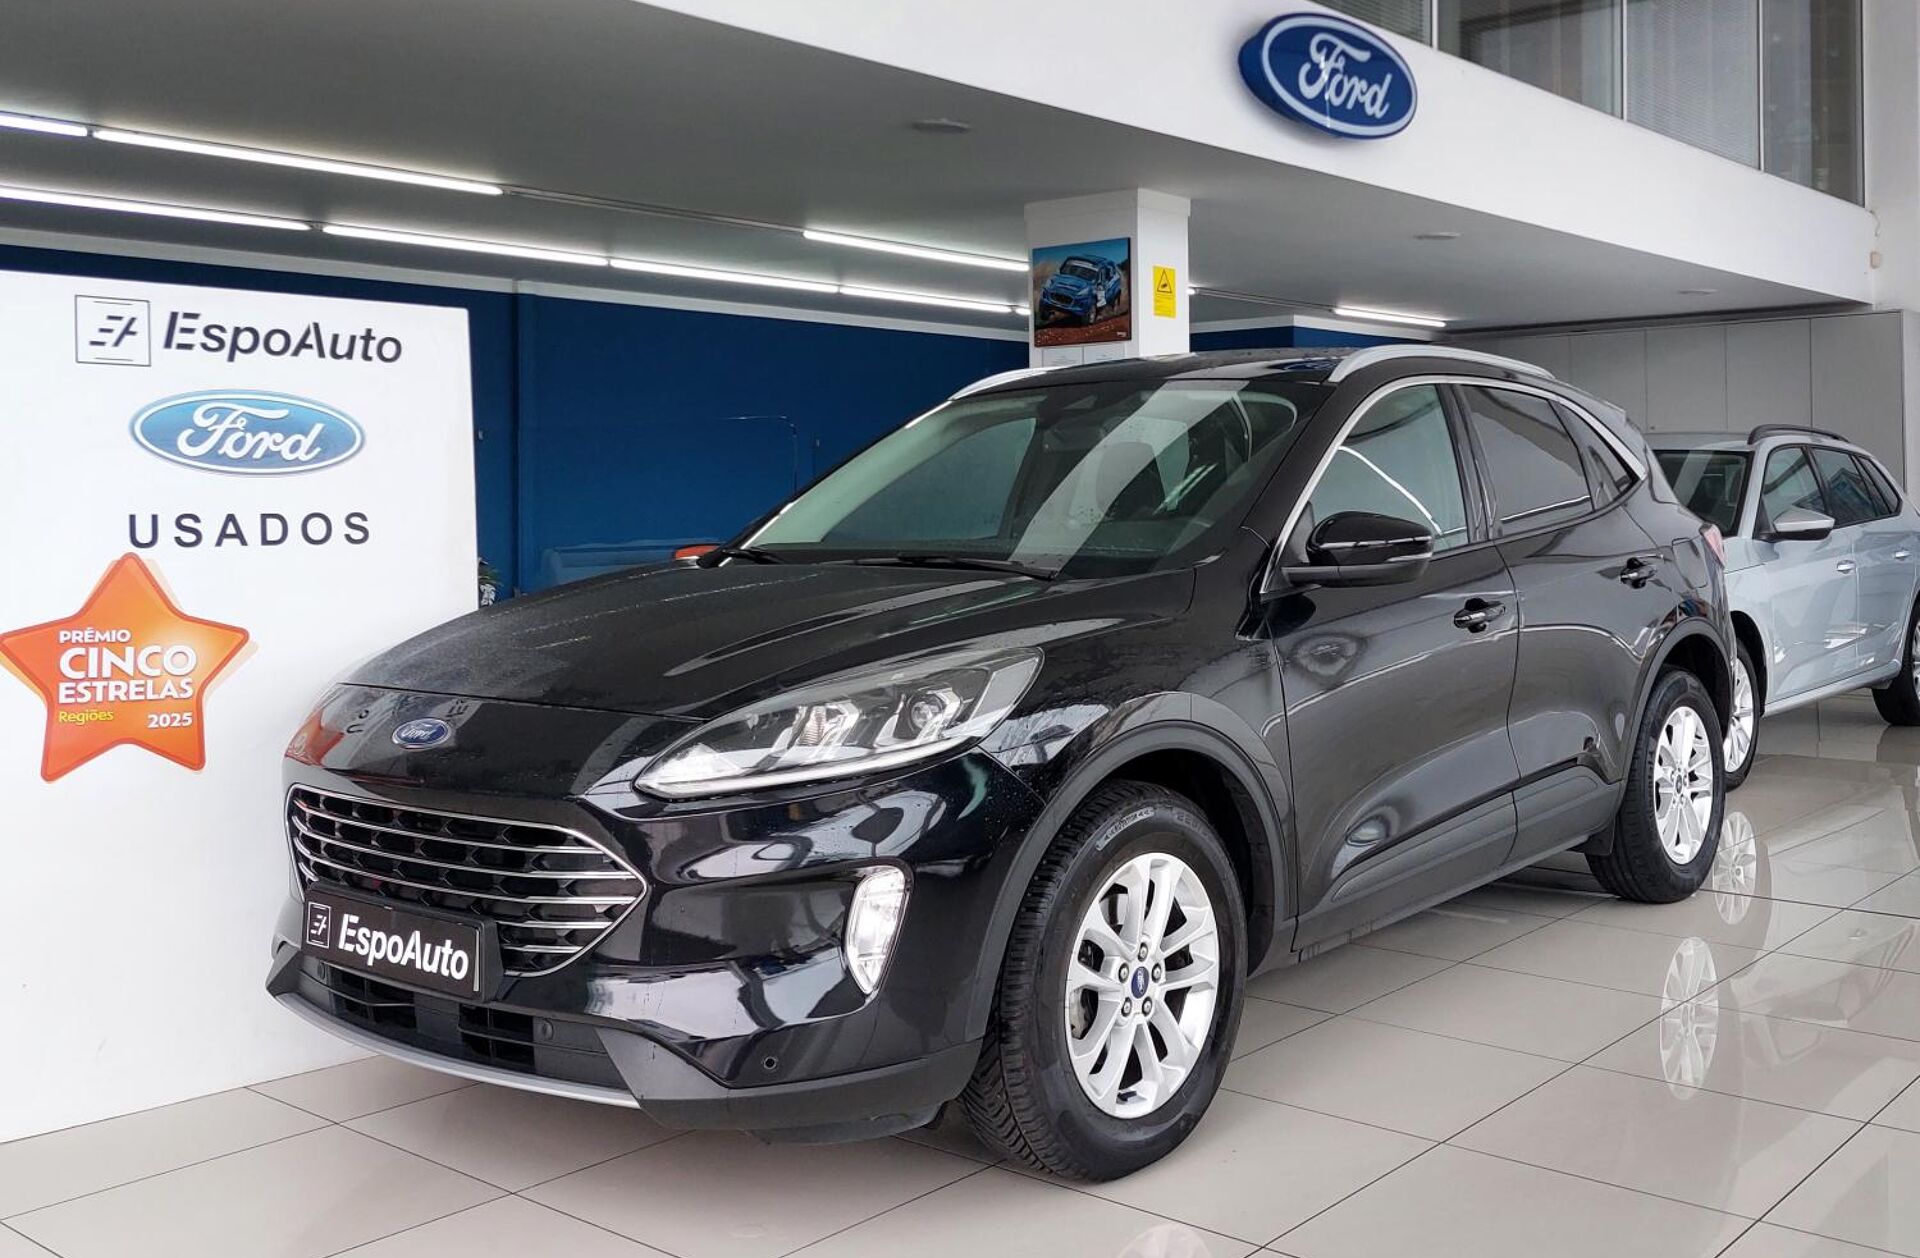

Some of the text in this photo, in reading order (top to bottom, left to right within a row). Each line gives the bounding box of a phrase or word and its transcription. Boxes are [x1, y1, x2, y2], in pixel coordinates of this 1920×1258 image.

[1298, 32, 1392, 119] Ford
[163, 311, 402, 363] EspoAuto
[177, 402, 325, 461] Ford
[128, 512, 370, 548] USADOS
[59, 627, 131, 644] PRÉMIO
[59, 645, 197, 680] CINCO
[58, 678, 193, 704] ESTRELAS
[59, 709, 193, 728] Regiões 2025
[338, 913, 469, 980] EspoAuto
